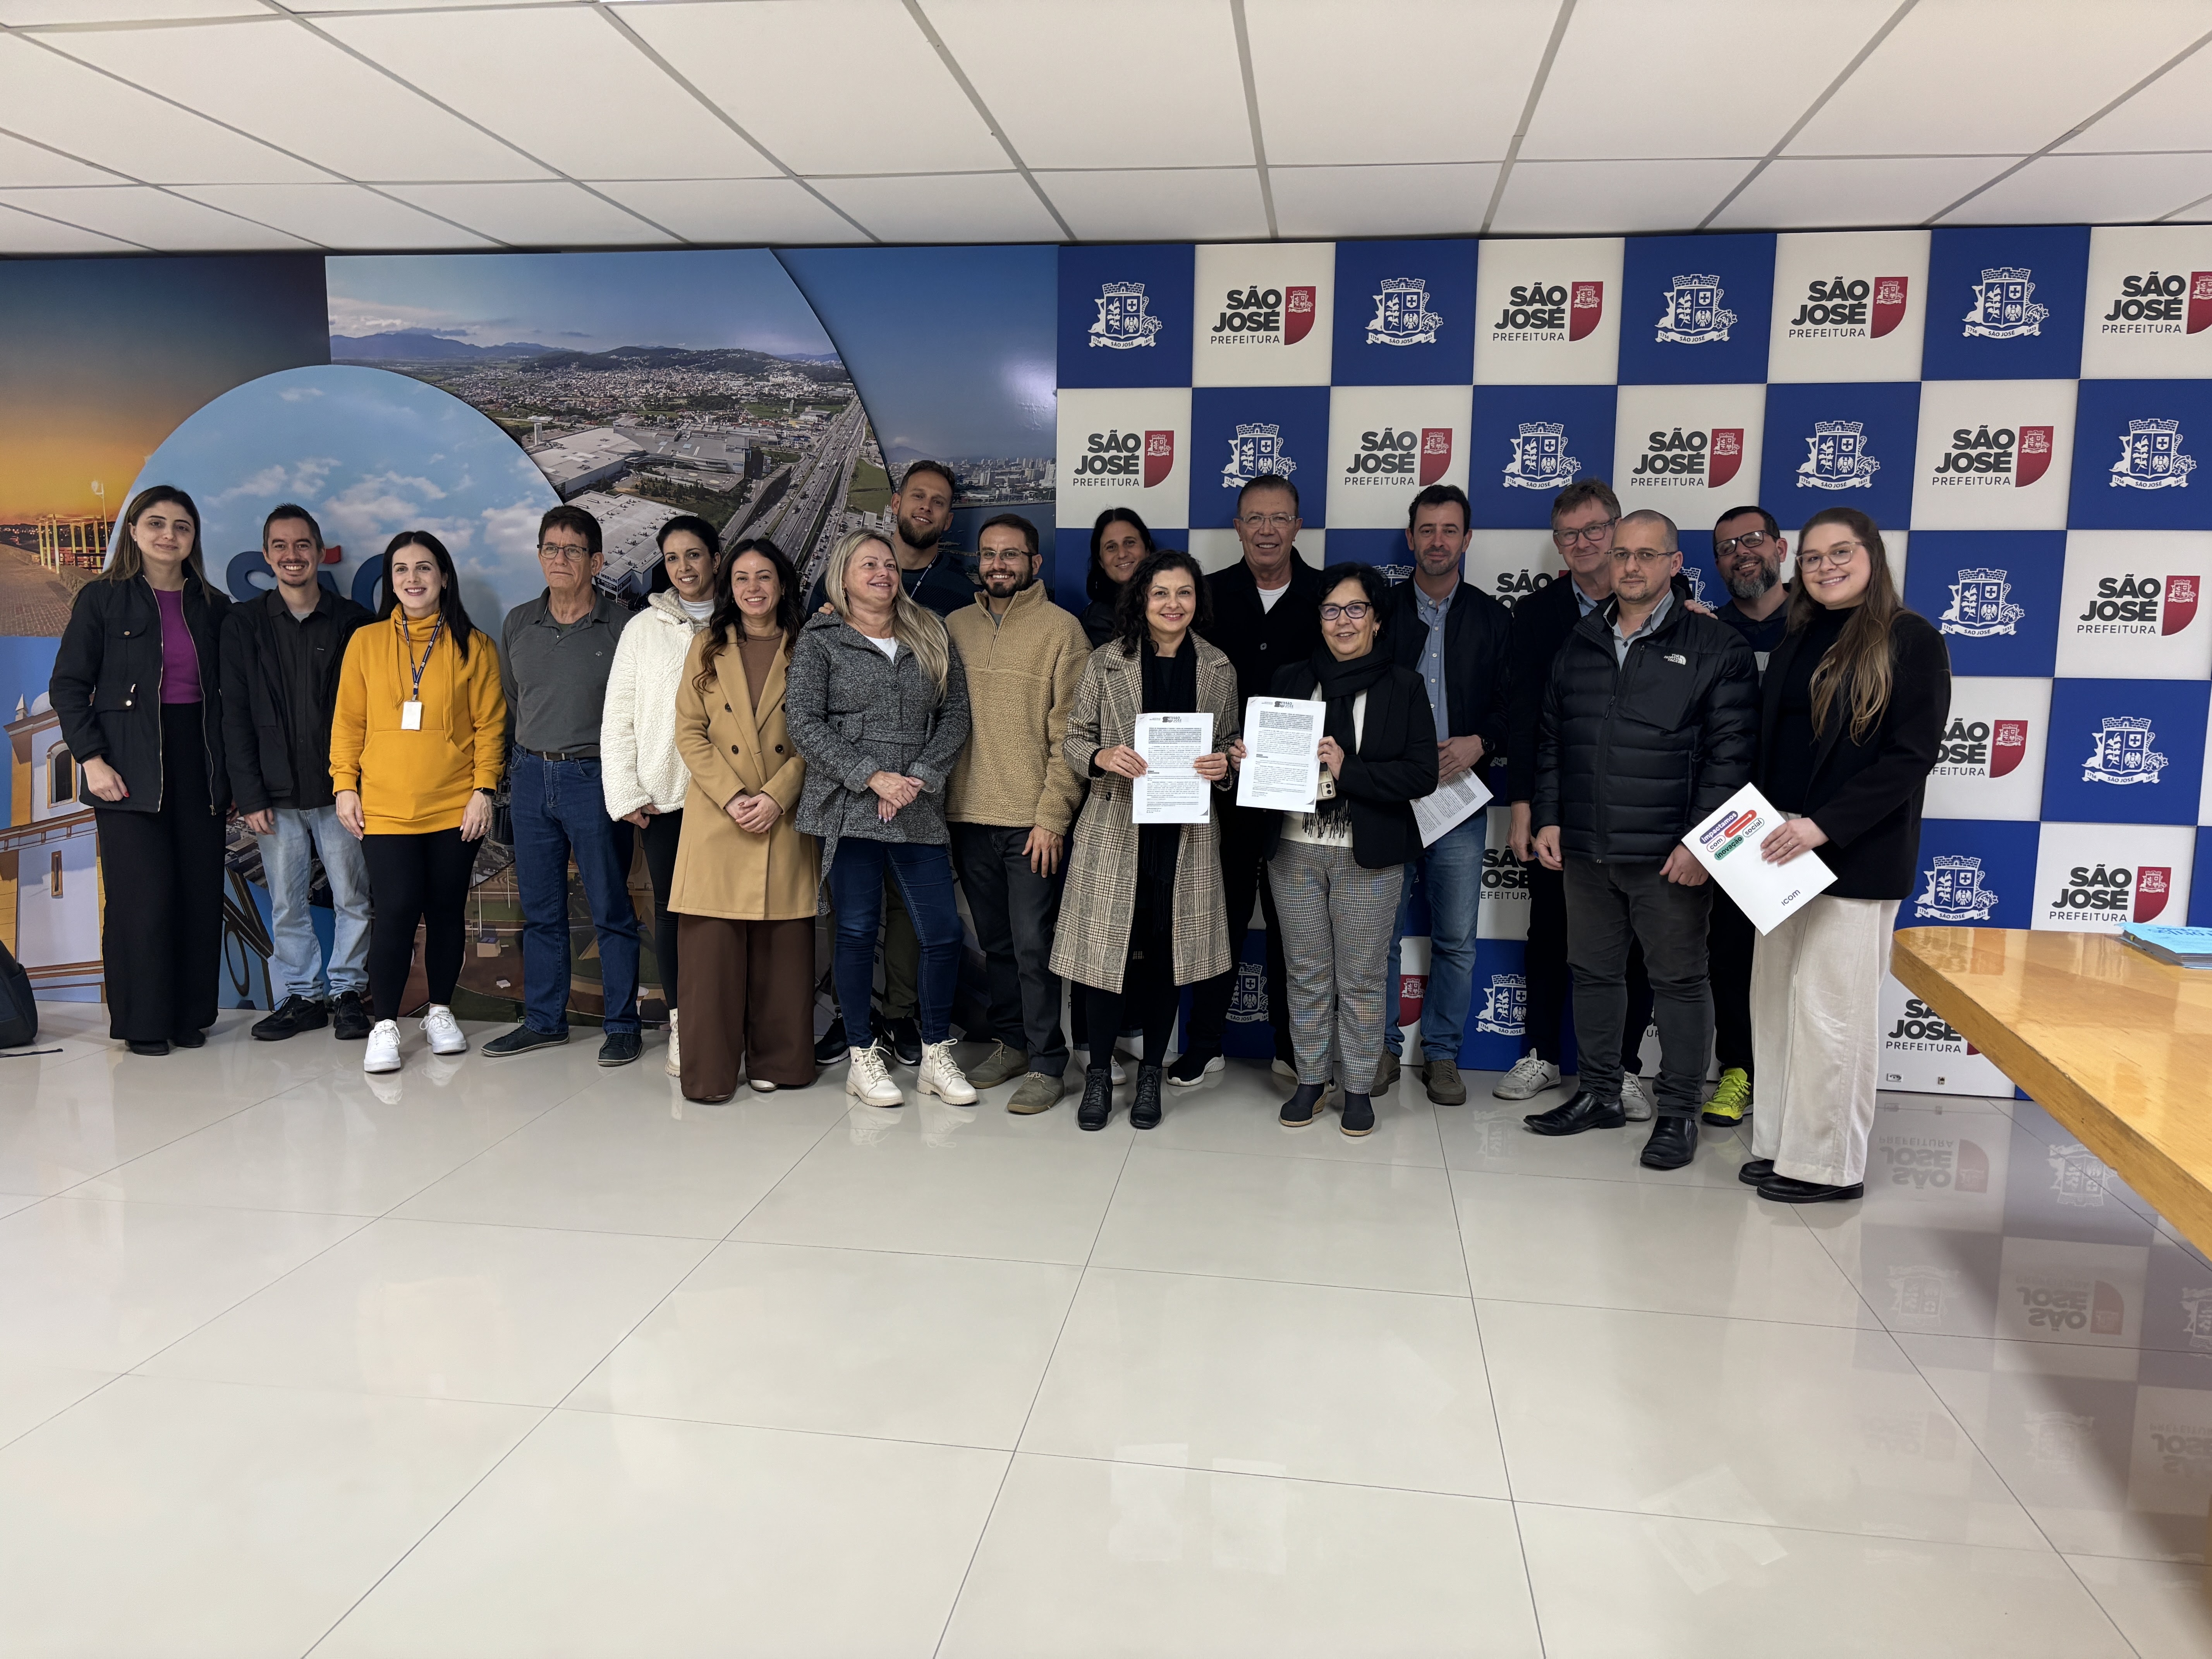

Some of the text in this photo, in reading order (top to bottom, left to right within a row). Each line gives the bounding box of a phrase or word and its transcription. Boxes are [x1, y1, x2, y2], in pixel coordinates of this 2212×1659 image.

[1509, 282, 1567, 307] SÃO
[1807, 276, 1870, 302] SÃO
[2121, 271, 2186, 297] SÃO
[1226, 285, 1282, 310] SÃO
[2104, 297, 2183, 321] JOSÉ
[1212, 309, 1280, 333] JOSÉ
[1494, 306, 1565, 330] JOSÉ
[1791, 301, 1867, 326] JOSÉ
[1211, 335, 1280, 344] PREFEITURA
[1493, 332, 1565, 341] PREFEITURA
[1789, 328, 1865, 338] PREFEITURA
[2102, 324, 2181, 333] PREFEITURA
[1087, 429, 1141, 453] SÃO
[1360, 427, 1418, 452] SÃO
[1648, 427, 1707, 452] SÃO
[1951, 424, 2016, 450] SÃO
[1074, 453, 1140, 475] JOSÉ
[1346, 452, 1415, 474] JOSÉ
[1632, 452, 1705, 475] JOSÉ
[1934, 450, 2013, 474] JOSÉ
[1073, 478, 1139, 486] PREFEITURA
[1345, 477, 1415, 485] PREFEITURA
[1631, 477, 1704, 486] PREFEITURA
[1932, 476, 2011, 486] PREFEITURA
[1496, 569, 1553, 593] SÃO
[2096, 574, 2161, 599] SÃO
[2079, 599, 2158, 622] JOSÉ
[2077, 625, 2156, 634] PREFEITURA
[1941, 718, 1990, 742] ÃO
[1936, 742, 1987, 764] OSÉ
[1933, 767, 1985, 776] FEITURA
[1701, 812, 1737, 842] Impactamos
[1745, 819, 1762, 835] social
[1710, 838, 1723, 850] com
[1482, 845, 1527, 868] SÃ
[1482, 869, 1527, 890] OS
[2068, 864, 2133, 889] SÃO
[1480, 891, 1531, 900] EFEITUR
[2051, 888, 2129, 910] JOSÉ
[2049, 911, 2127, 922] PREFEITURA
[1886, 1041, 1961, 1053] PREFEITURA
